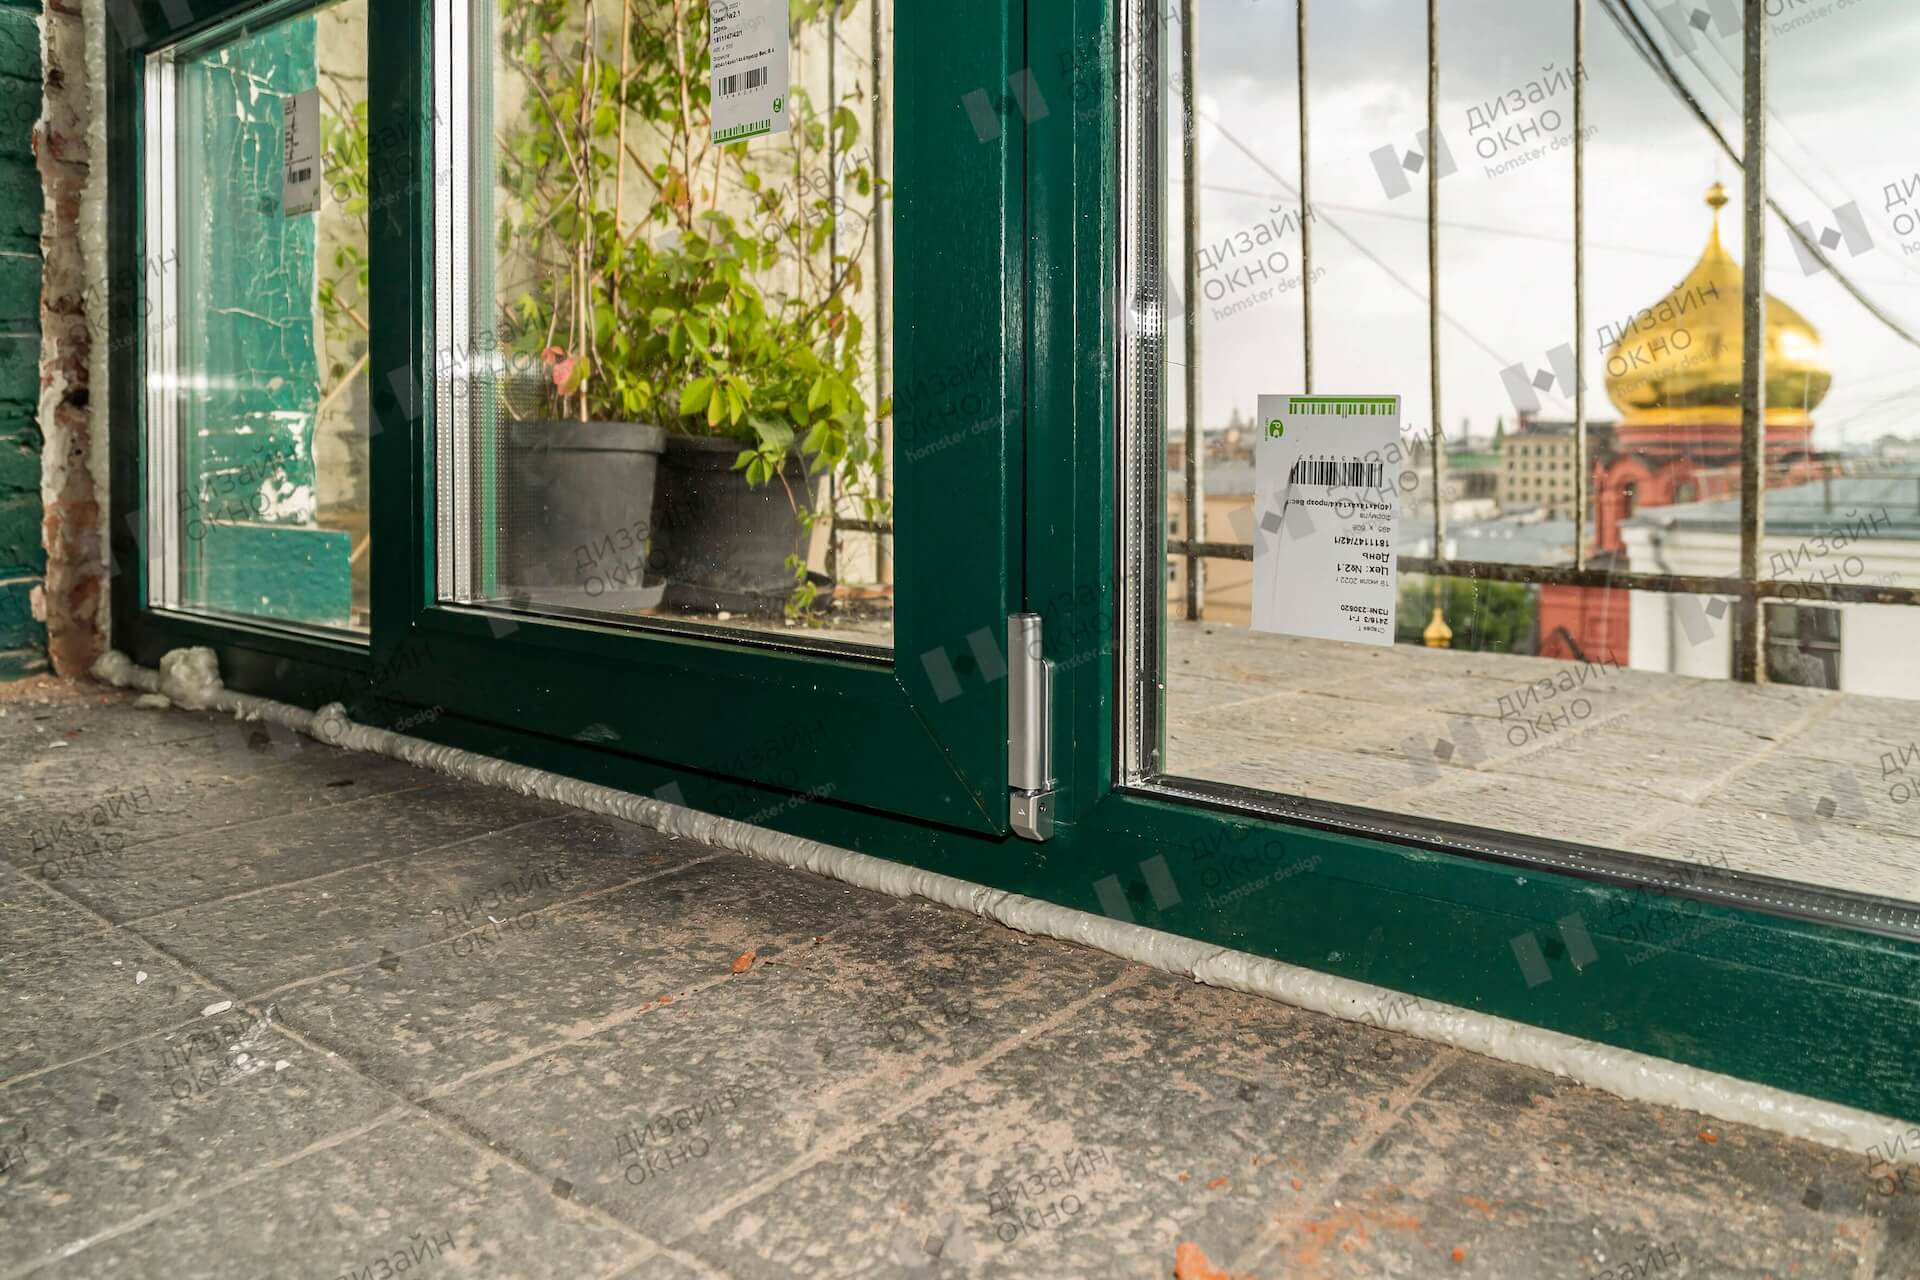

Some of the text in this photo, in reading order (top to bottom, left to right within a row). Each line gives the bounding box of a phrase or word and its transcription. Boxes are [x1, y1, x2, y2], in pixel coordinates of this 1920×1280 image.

[1334, 536, 1390, 547] 1811147/42/1
[1362, 552, 1390, 563] День
[1337, 563, 1388, 576] Цех: №2.1
